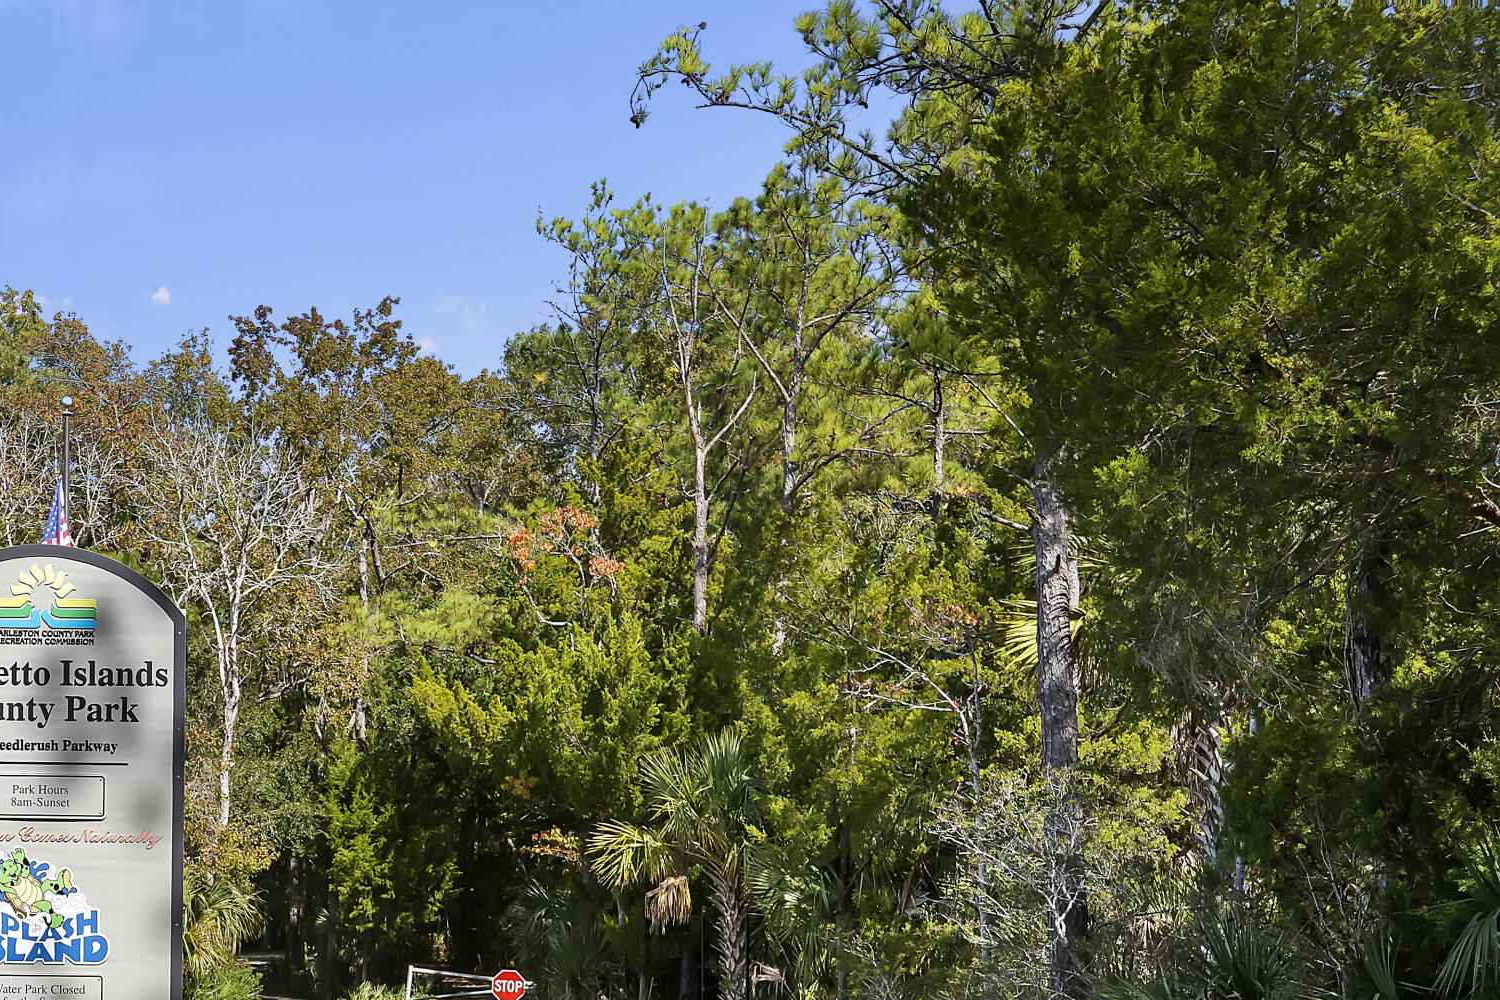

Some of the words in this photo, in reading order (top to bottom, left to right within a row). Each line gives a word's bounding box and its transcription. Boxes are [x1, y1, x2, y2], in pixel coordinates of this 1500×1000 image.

[41, 630, 74, 638] COUNTY
[75, 630, 94, 638] PARK
[44, 638, 94, 646] COMMISSION
[60, 660, 169, 687] Islands
[64, 696, 139, 723] Park
[62, 740, 118, 754] Parkway
[12, 784, 35, 795] Park
[38, 784, 69, 795] Hours
[11, 797, 70, 808] 8am-Sunset
[18, 826, 74, 843] Comes
[74, 828, 163, 850] Naturally
[25, 984, 47, 995] Park
[50, 985, 86, 995] Closed
[494, 980, 523, 993] STOP
